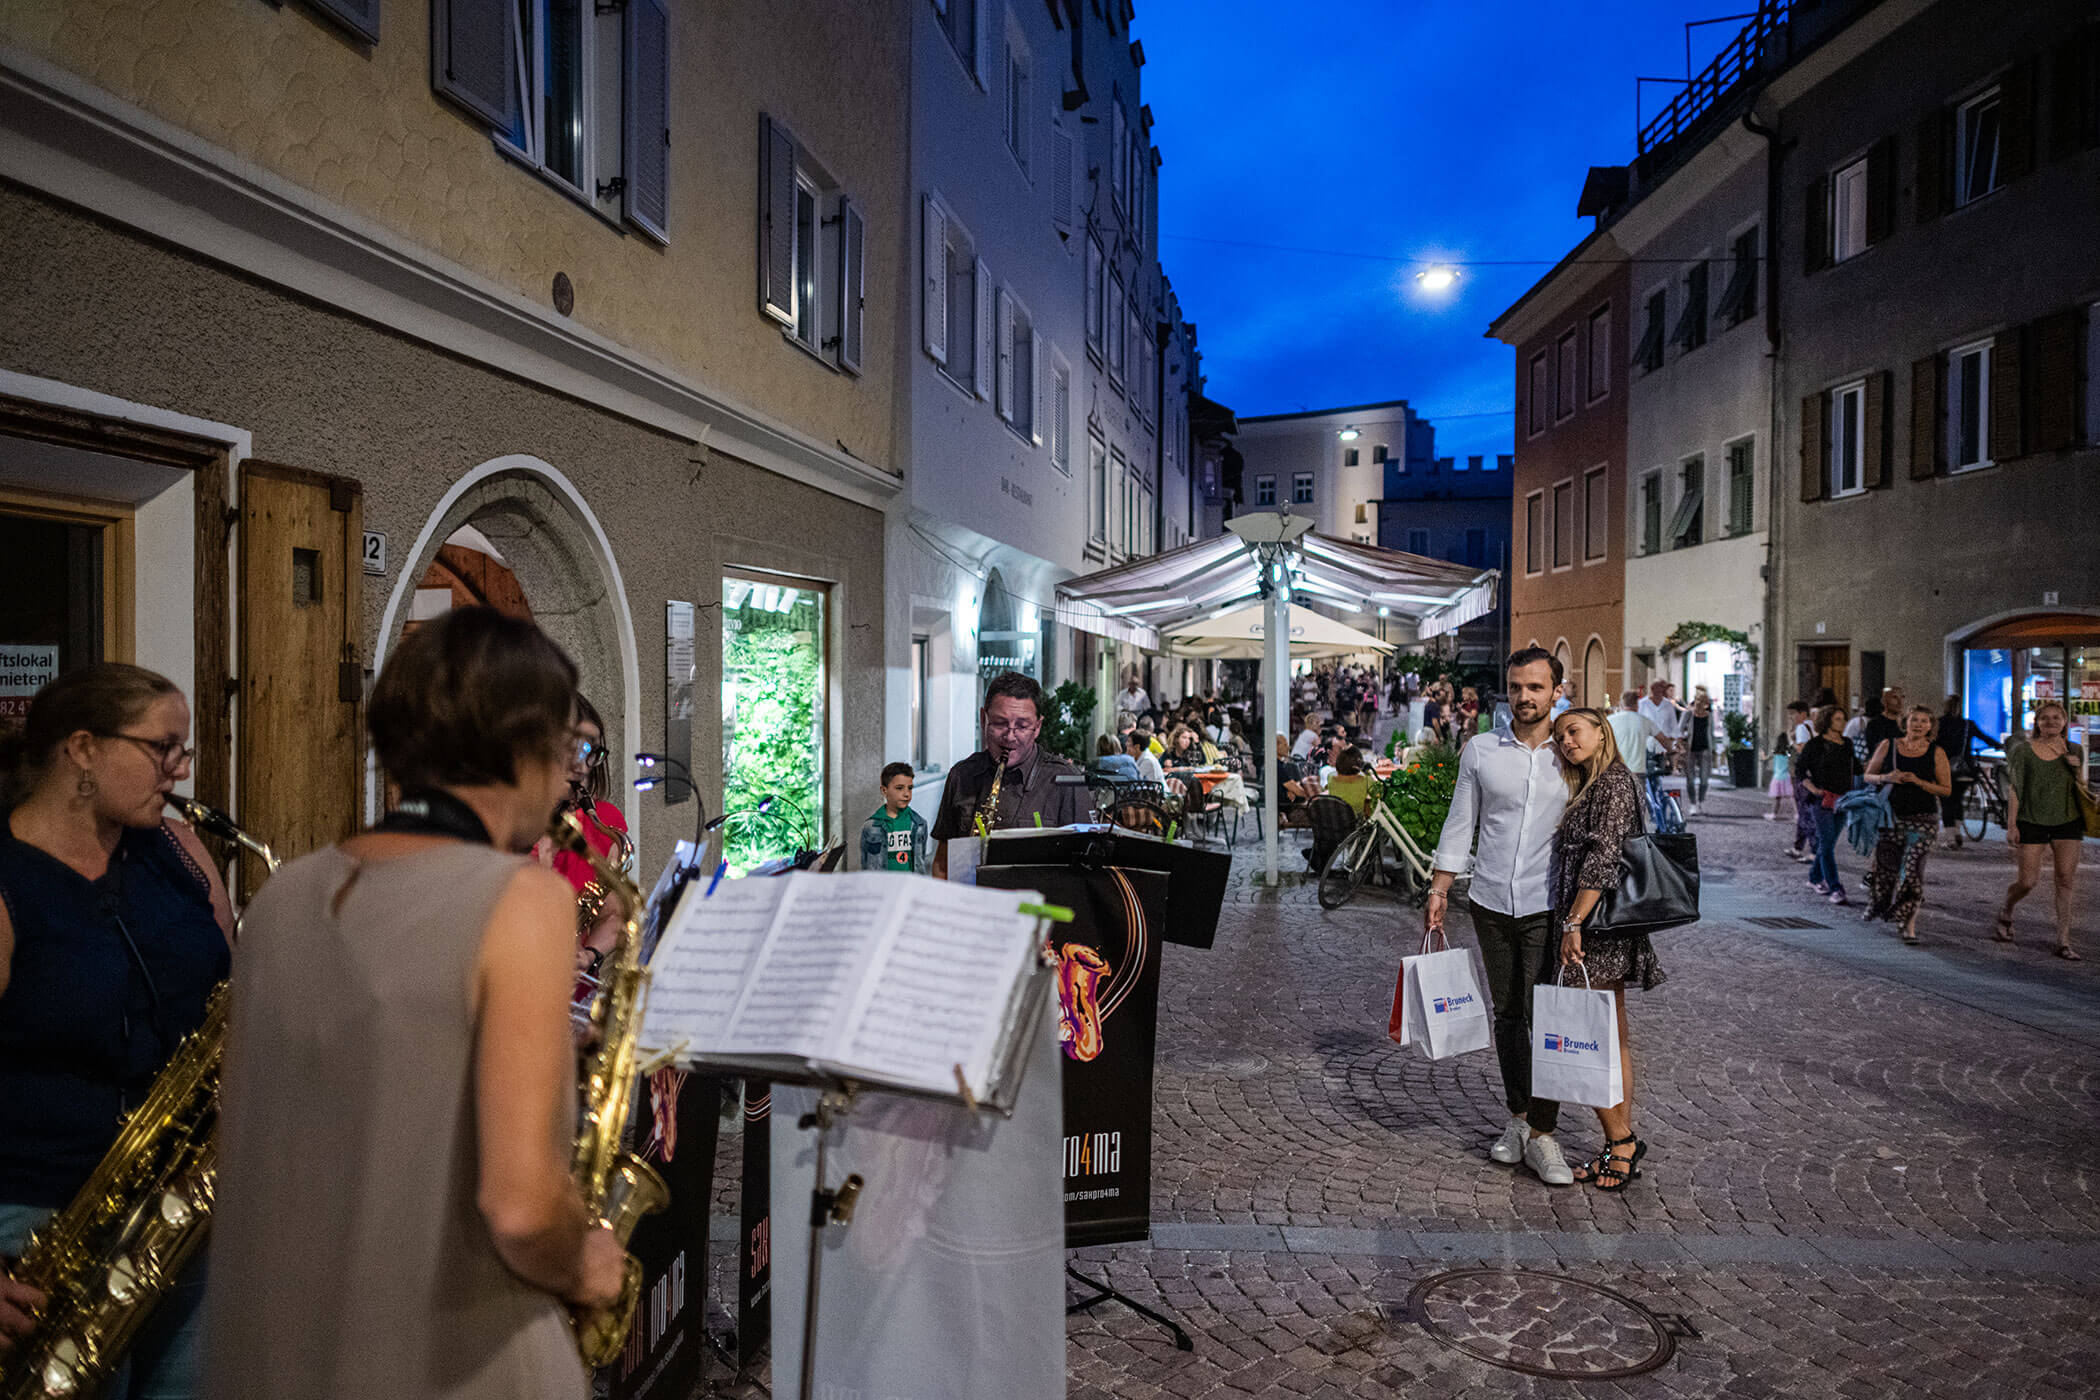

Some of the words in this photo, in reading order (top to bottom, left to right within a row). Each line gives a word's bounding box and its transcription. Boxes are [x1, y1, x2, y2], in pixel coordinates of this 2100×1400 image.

[363, 535, 380, 560] 12
[1447, 992, 1473, 1006] Bruneck
[1564, 1036, 1600, 1052] Bruneck
